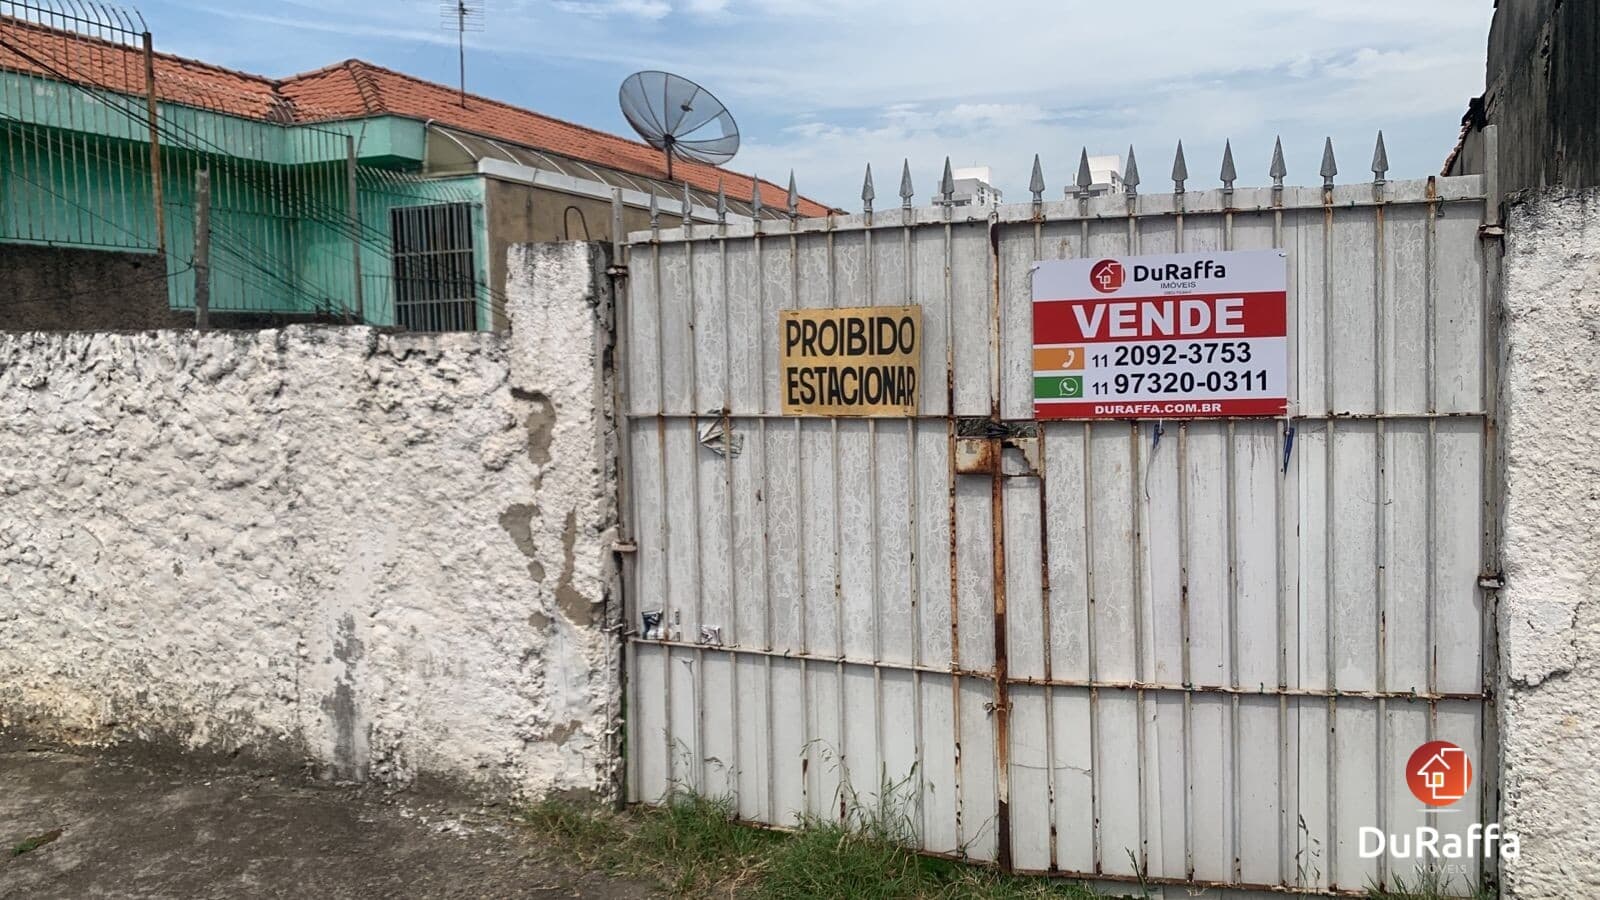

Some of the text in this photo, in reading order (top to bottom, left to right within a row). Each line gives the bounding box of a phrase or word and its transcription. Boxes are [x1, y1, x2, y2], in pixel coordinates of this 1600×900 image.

[1133, 260, 1226, 282] DuRaffa
[1160, 281, 1197, 289] IMÓVEIS
[1072, 298, 1245, 339] VENDE
[786, 316, 915, 357] PROIBIDO
[1092, 342, 1251, 368] 11 2092-3753
[786, 366, 916, 406] ESTACIONAR
[1092, 370, 1267, 395] 11 97320-0311
[1094, 403, 1222, 415] DURAFFA.COM.BR
